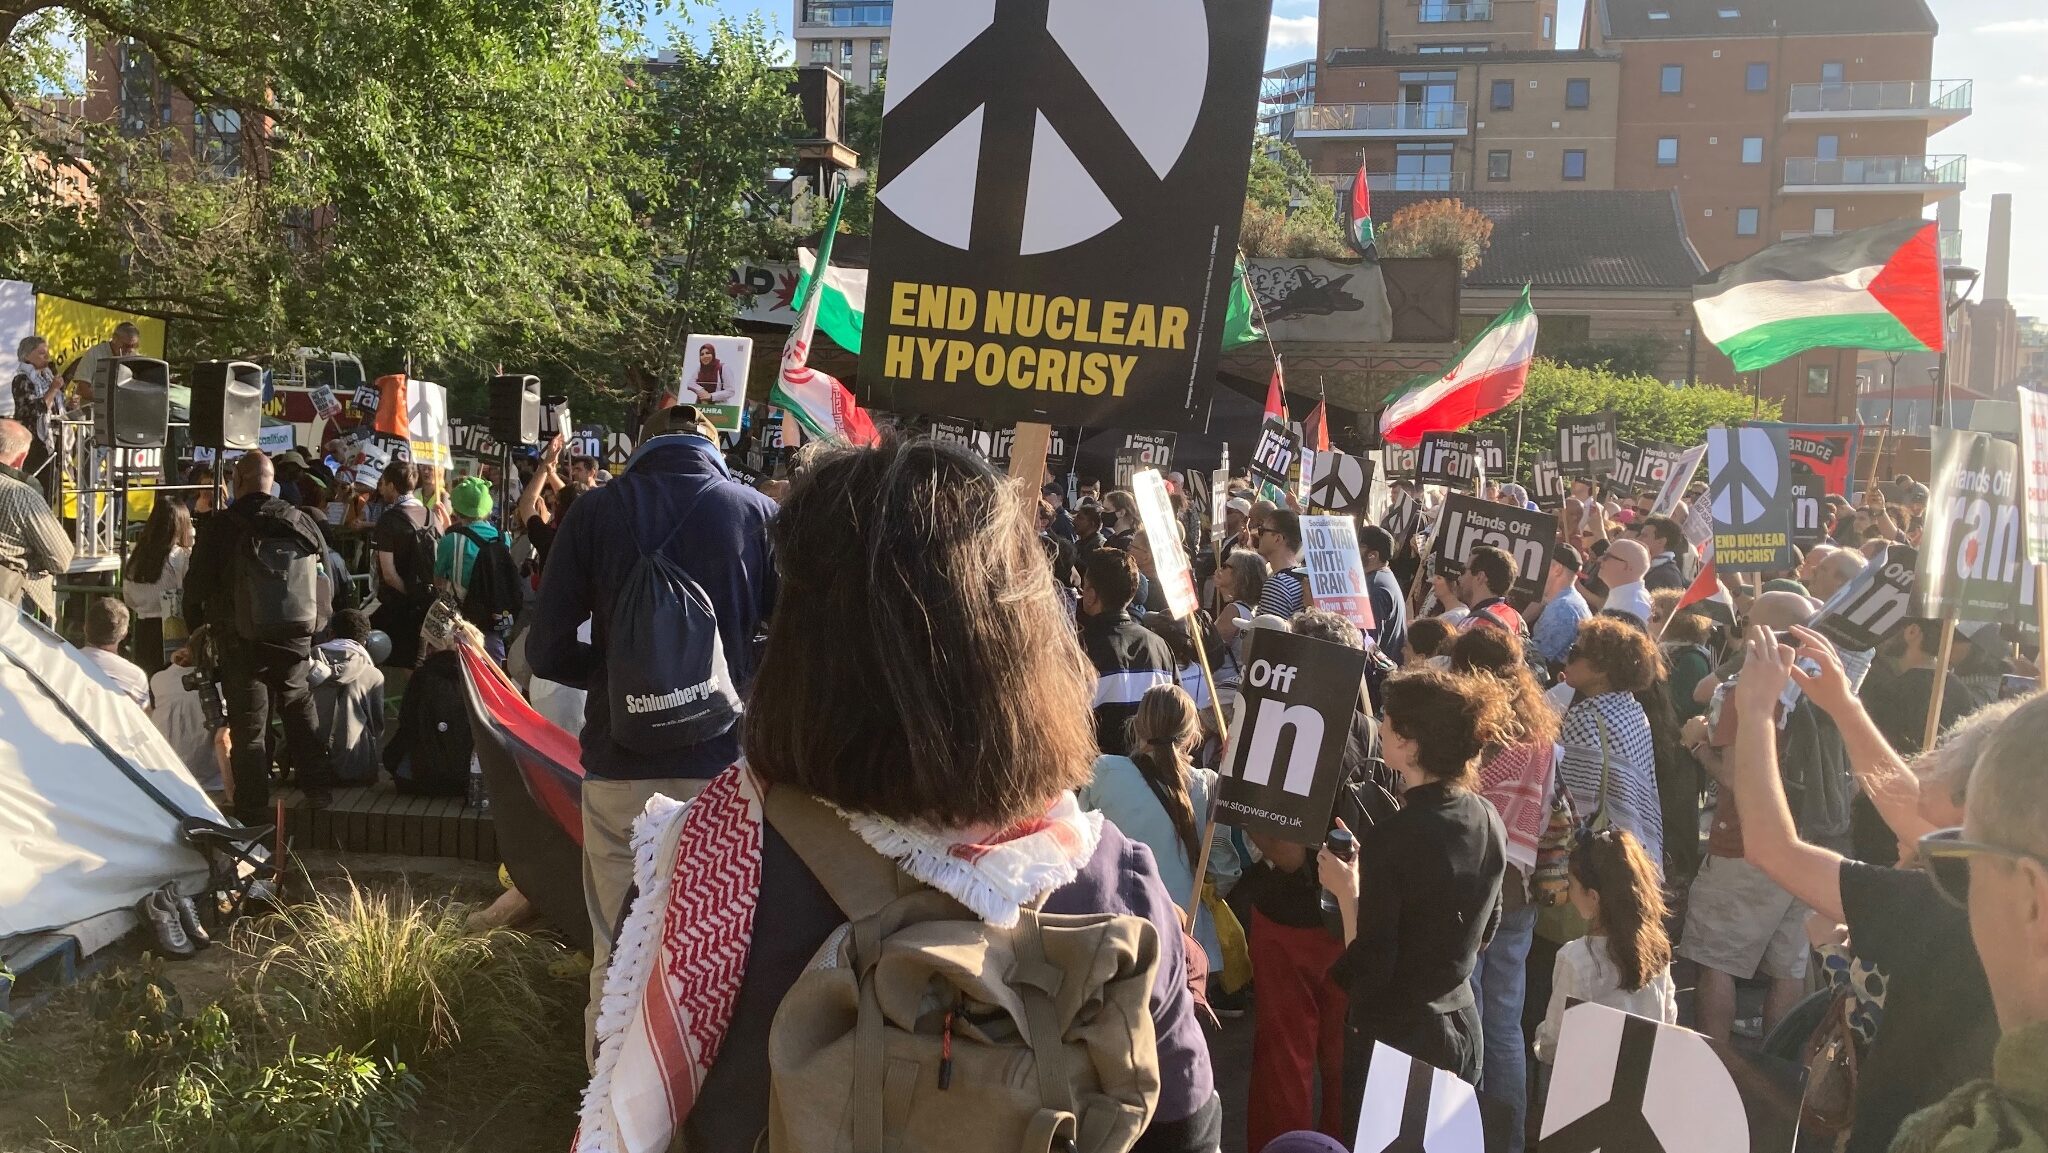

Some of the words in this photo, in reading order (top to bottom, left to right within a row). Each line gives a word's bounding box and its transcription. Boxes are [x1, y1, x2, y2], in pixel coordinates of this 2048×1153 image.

[890, 282, 977, 331] END
[984, 290, 1189, 350] NUCLEAR
[884, 335, 1139, 396] HYPOCRISY
[762, 426, 784, 448] Ira
[938, 422, 954, 432] Hands
[955, 426, 964, 434] Off
[1134, 434, 1153, 442] Hands
[1154, 436, 1164, 444] Off
[1572, 425, 1596, 434] Hands
[1596, 422, 1606, 432] Off
[378, 438, 410, 462] Ira
[570, 437, 600, 457] an
[992, 431, 1016, 458] Ir
[1254, 429, 1292, 476] Iran
[1436, 438, 1459, 448] Hands
[1460, 442, 1468, 452] Off
[1560, 428, 1614, 462] Iran
[1646, 448, 1668, 458] Hands
[1789, 438, 1833, 461] BRIDGE
[1386, 444, 1420, 471] Ira
[1422, 442, 1472, 478] Iran
[1950, 461, 1990, 494] Hands
[1992, 469, 2012, 497] Off
[1792, 486, 1806, 496] Off
[1466, 510, 1506, 530] Hands
[1509, 520, 1532, 536] Off
[1306, 528, 1326, 550] NO
[1328, 528, 1355, 550] WAR
[1715, 534, 1736, 548] END
[1738, 532, 1786, 547] NUCLEAR
[1308, 550, 1346, 572] WITH
[1716, 549, 1776, 564] HYPOCRISY
[1314, 572, 1348, 594] IRAN
[1320, 600, 1341, 611] Down
[1342, 599, 1357, 610] with
[1250, 659, 1298, 694] Off
[626, 675, 720, 714] Schlumberger
